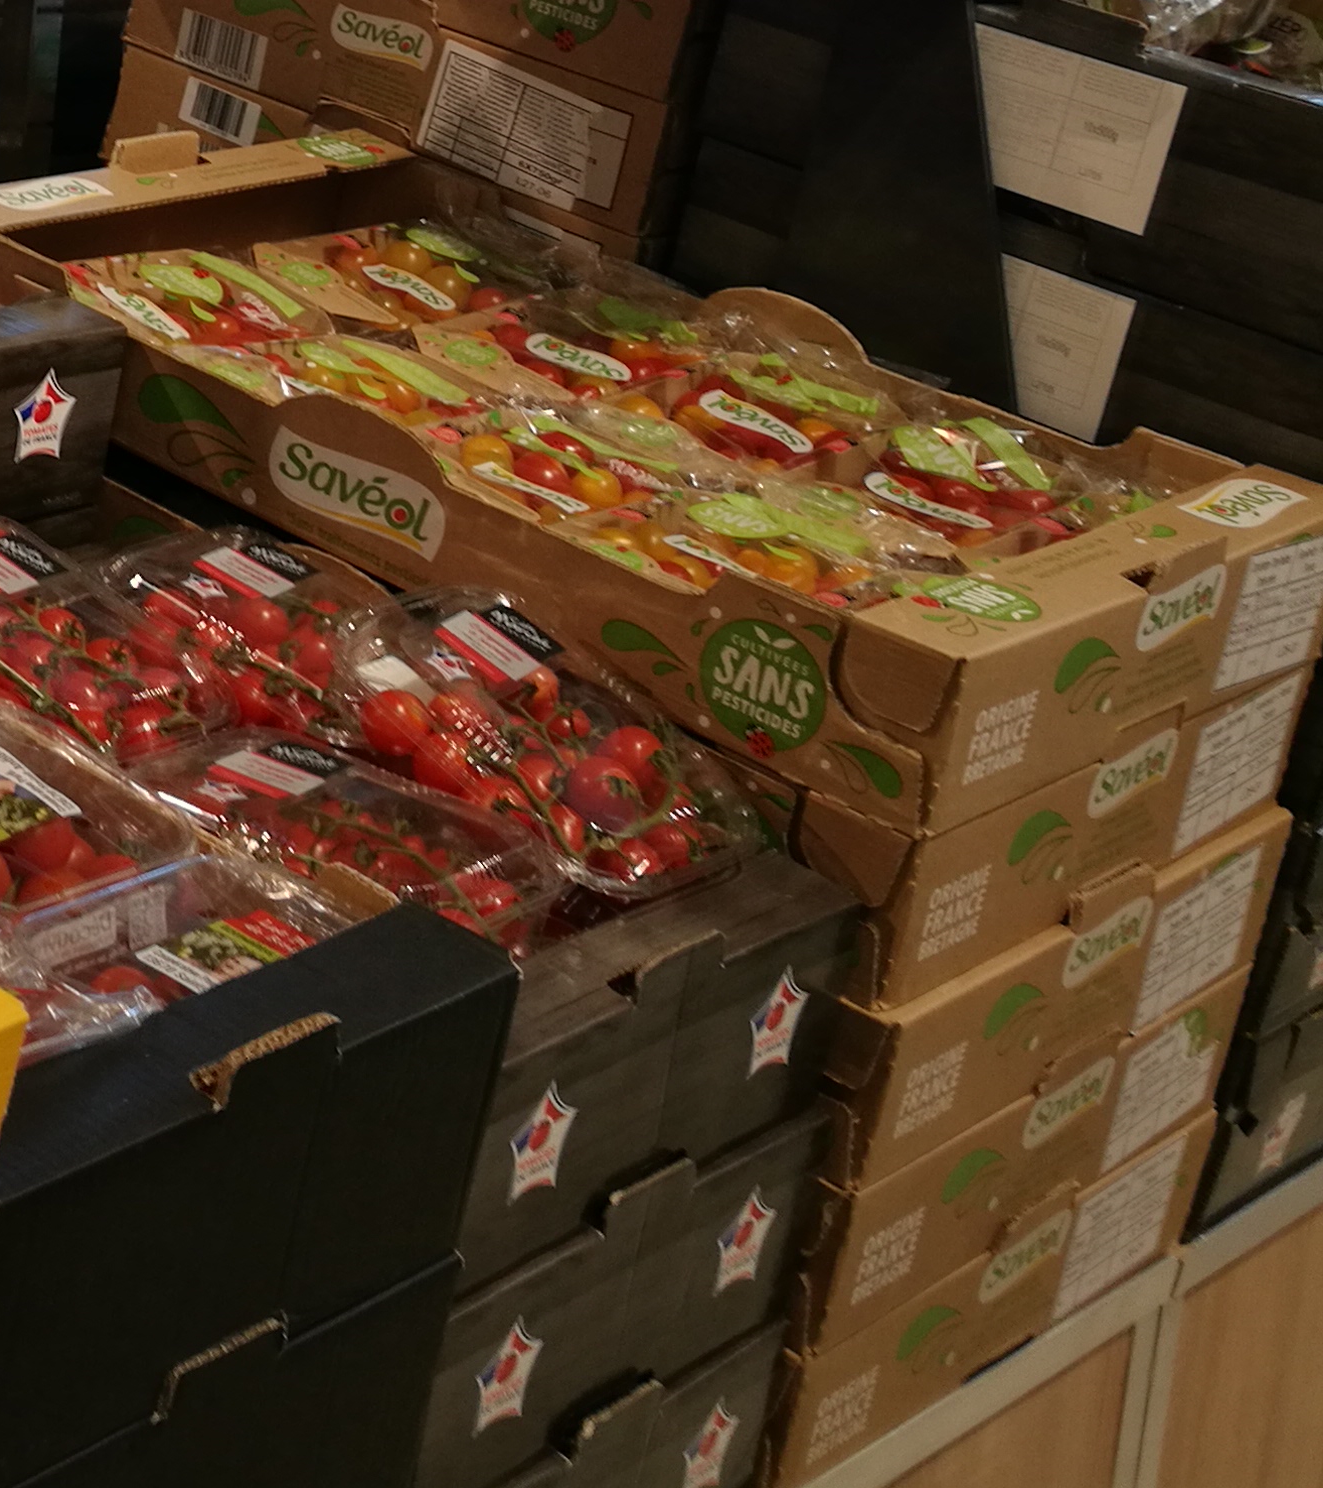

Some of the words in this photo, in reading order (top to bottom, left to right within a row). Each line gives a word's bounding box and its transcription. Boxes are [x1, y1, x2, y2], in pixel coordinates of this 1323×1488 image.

[338, 10, 424, 62] Savéol
[0, 178, 99, 209] Savéol
[365, 264, 450, 311] Savéol
[529, 337, 627, 381] Savéol
[709, 397, 808, 453] Savéol
[278, 442, 431, 543] Savéol
[1197, 483, 1292, 525] Savéol
[1143, 572, 1222, 637] Savéol
[730, 631, 810, 679] CULTIVÉES
[713, 646, 817, 721] SANS
[712, 686, 805, 740] PESTICIDES
[975, 690, 1040, 732] ORIGINE
[969, 713, 1033, 761] FRANCE
[963, 742, 1025, 786] BRETAGNE
[928, 864, 993, 910] ORIGINE
[922, 888, 986, 937] FRANCE
